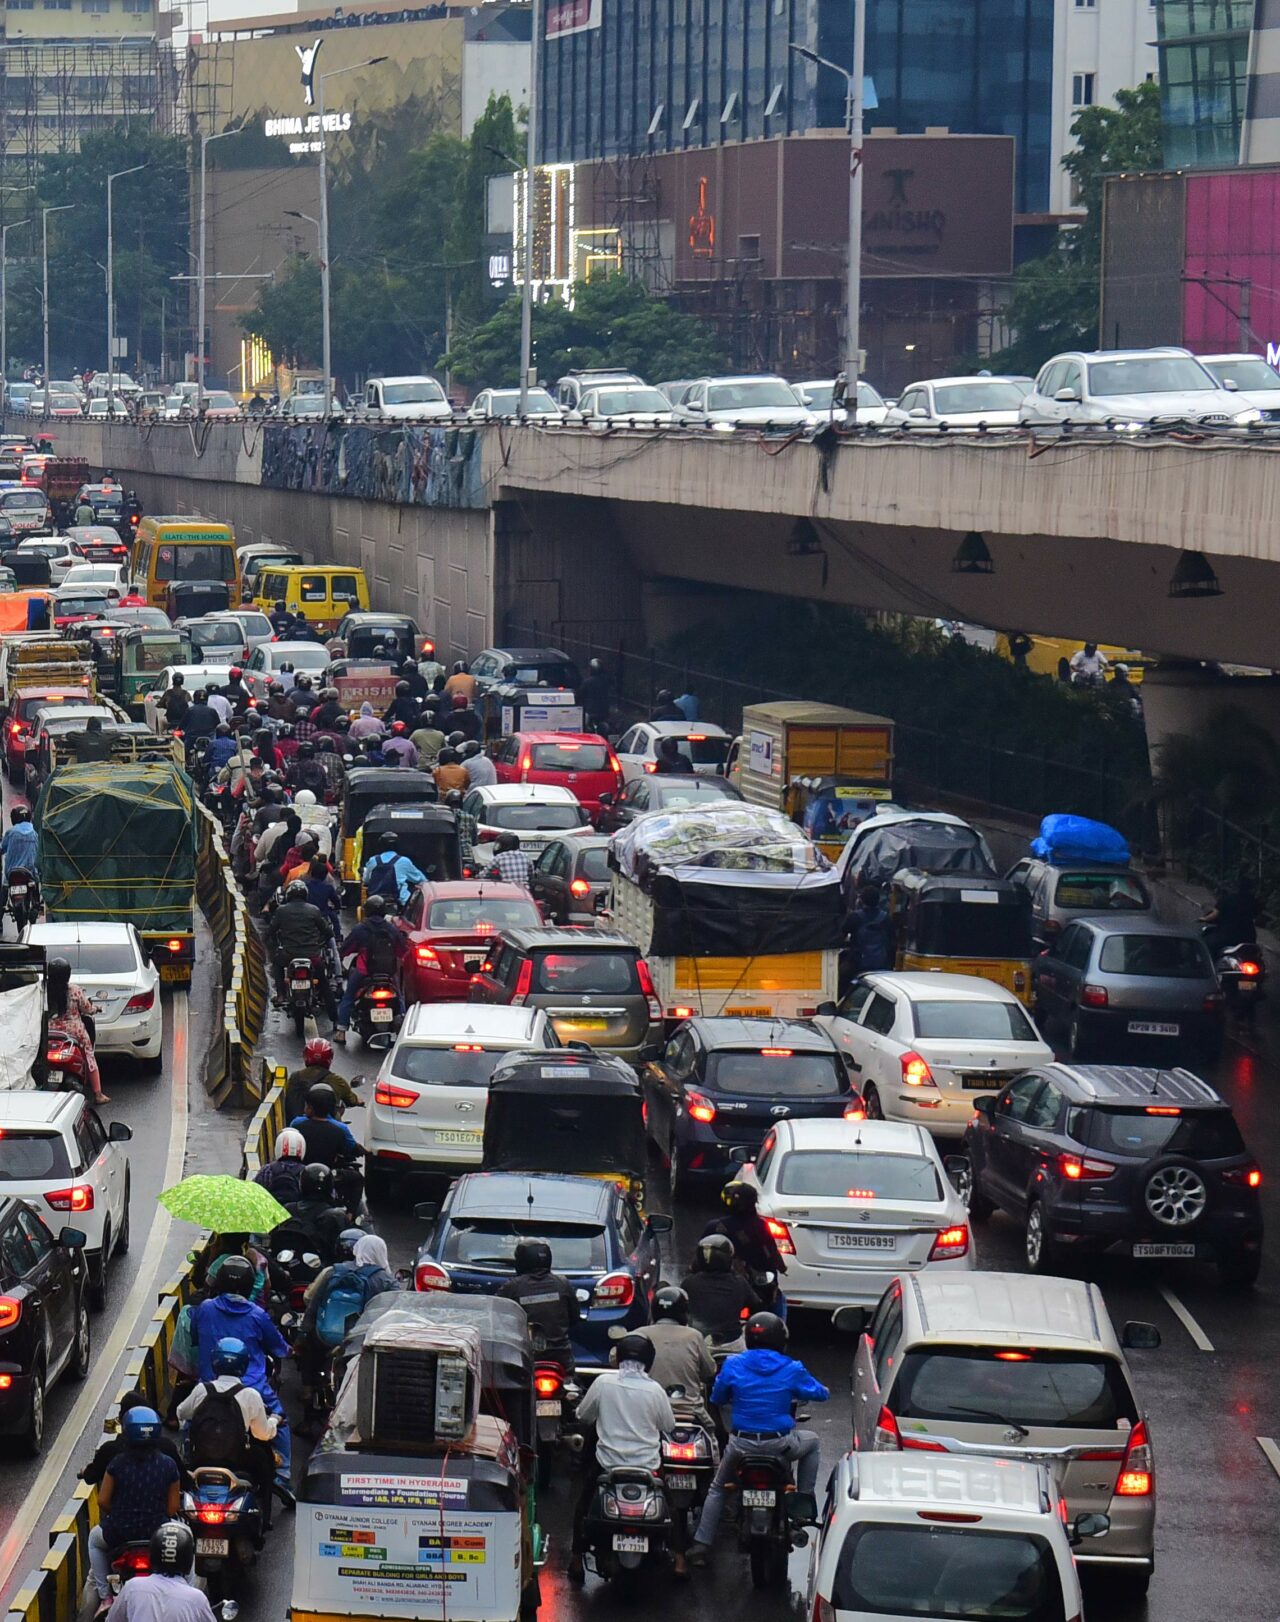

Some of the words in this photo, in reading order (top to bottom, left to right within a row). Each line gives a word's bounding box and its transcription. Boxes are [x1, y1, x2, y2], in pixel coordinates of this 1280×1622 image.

[265, 117, 303, 137] BHIMA
[304, 112, 351, 133] JEWELS
[289, 142, 309, 153] SINCE
[862, 209, 945, 241] ANISHQ
[833, 1235, 894, 1248] TS09EU6899
[347, 1477, 371, 1485] FIRST
[397, 1478, 406, 1486] IN
[408, 1479, 461, 1489] HYDERABAD
[341, 1488, 389, 1496] Intermediate
[397, 1490, 438, 1498] Foundation
[374, 1496, 390, 1504] IAS,
[324, 1513, 348, 1522] GYANAM
